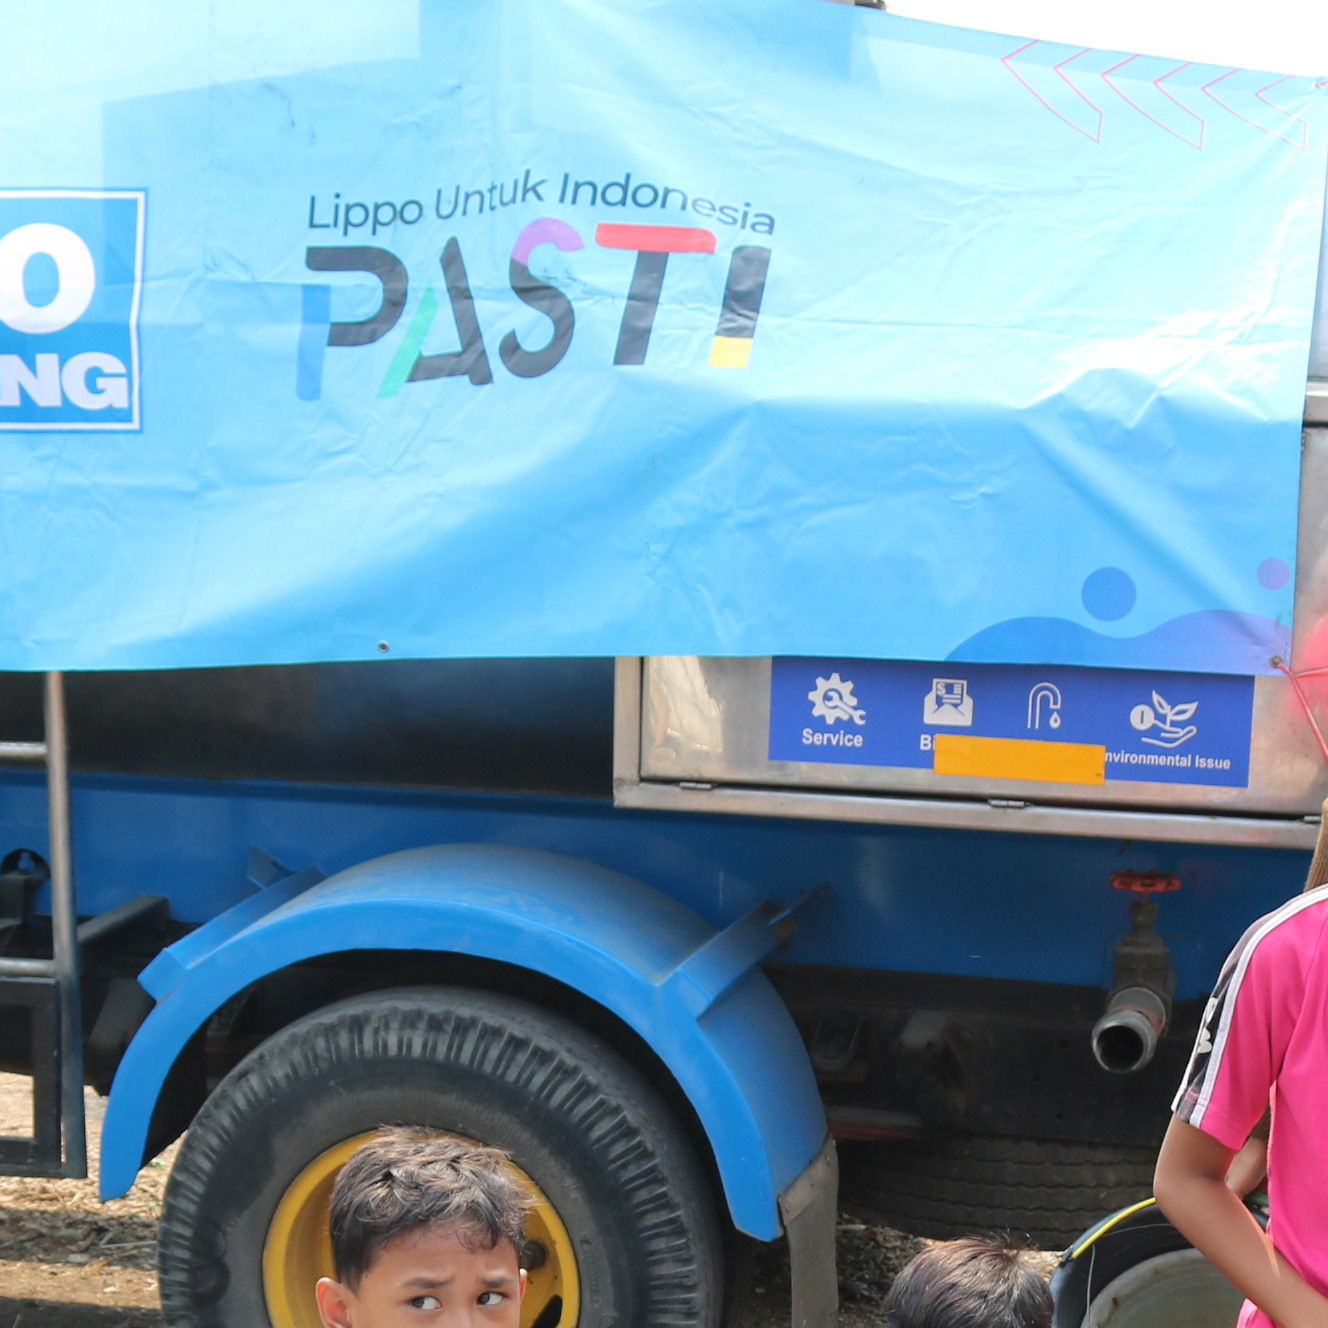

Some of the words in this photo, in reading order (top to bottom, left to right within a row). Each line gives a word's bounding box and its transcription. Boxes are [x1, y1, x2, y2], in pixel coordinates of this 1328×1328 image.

[307, 192, 423, 236] Lippo
[434, 169, 546, 221] Untuk
[557, 172, 776, 236] Indonesia
[295, 216, 772, 401] PASTI
[802, 728, 863, 748] Service
[1105, 751, 1192, 768] nvironmental
[1195, 755, 1231, 771] Issue
